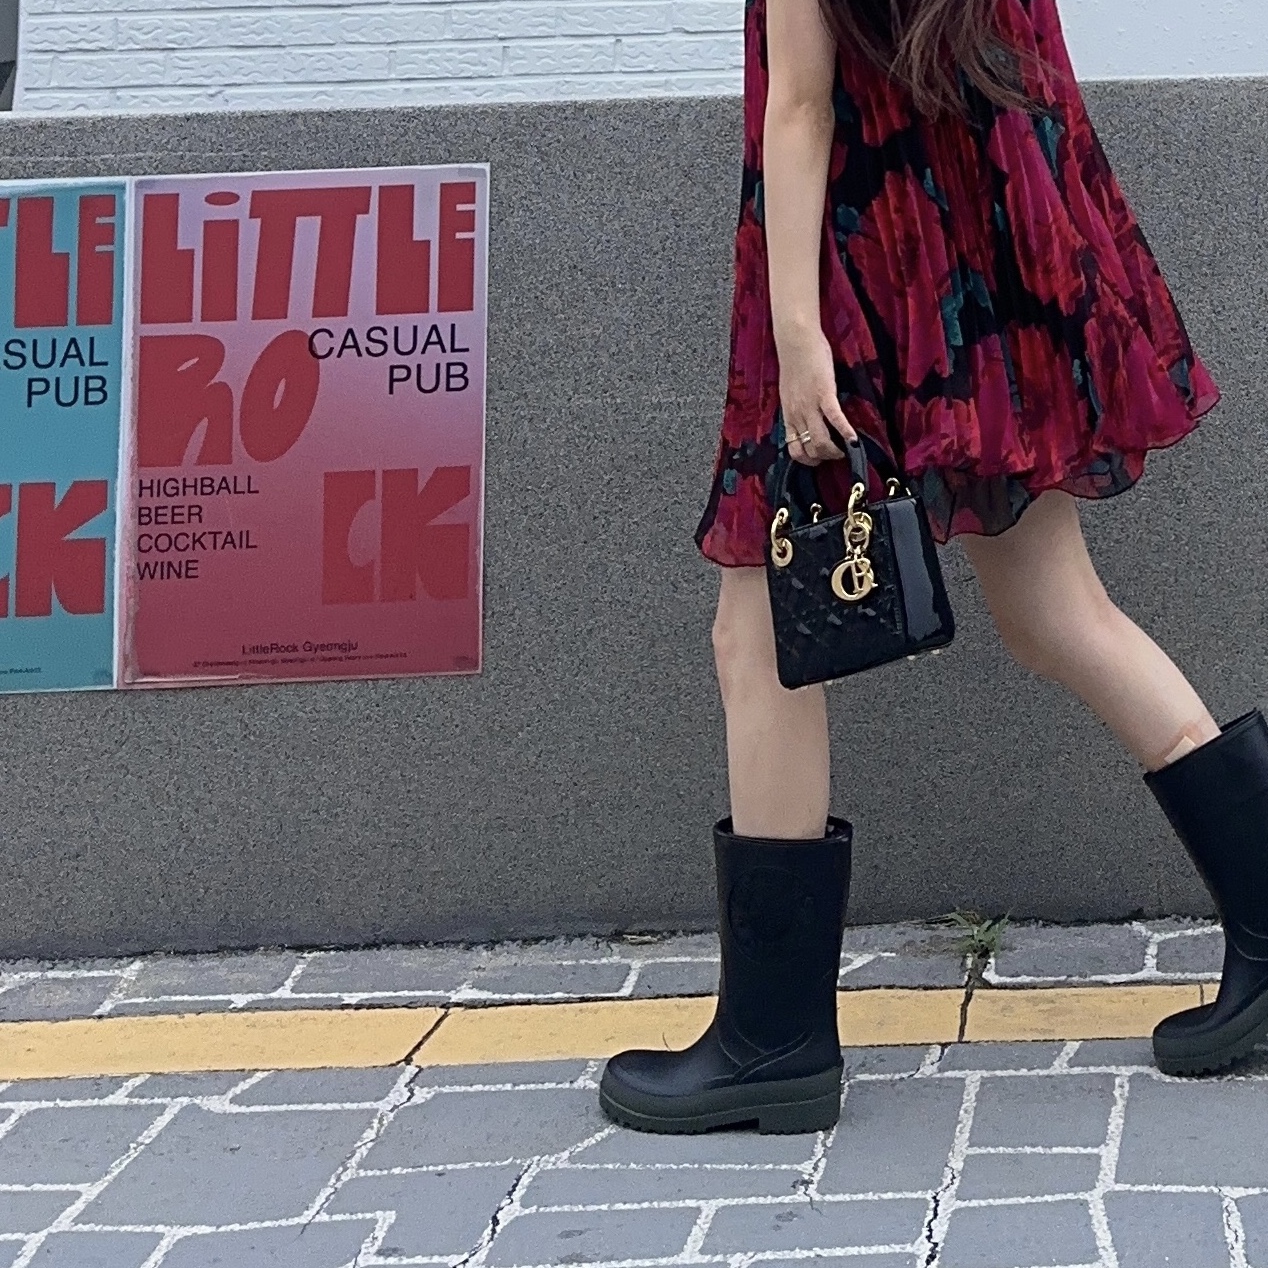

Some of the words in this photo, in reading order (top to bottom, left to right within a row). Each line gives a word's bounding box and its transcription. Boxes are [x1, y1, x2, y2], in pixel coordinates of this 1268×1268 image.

[0, 194, 116, 328] LE
[0, 336, 109, 370] SUAL
[308, 323, 470, 360] CASUAL
[26, 375, 108, 408] PUB
[388, 361, 470, 395] PUB
[138, 476, 259, 498] HIGHBALL
[138, 505, 203, 526] BEER
[0, 480, 108, 618] K
[138, 530, 258, 553] COCKTAIL
[138, 560, 199, 580] WINE
[241, 642, 300, 656] LittleRock
[302, 639, 359, 654] Gyeongju
